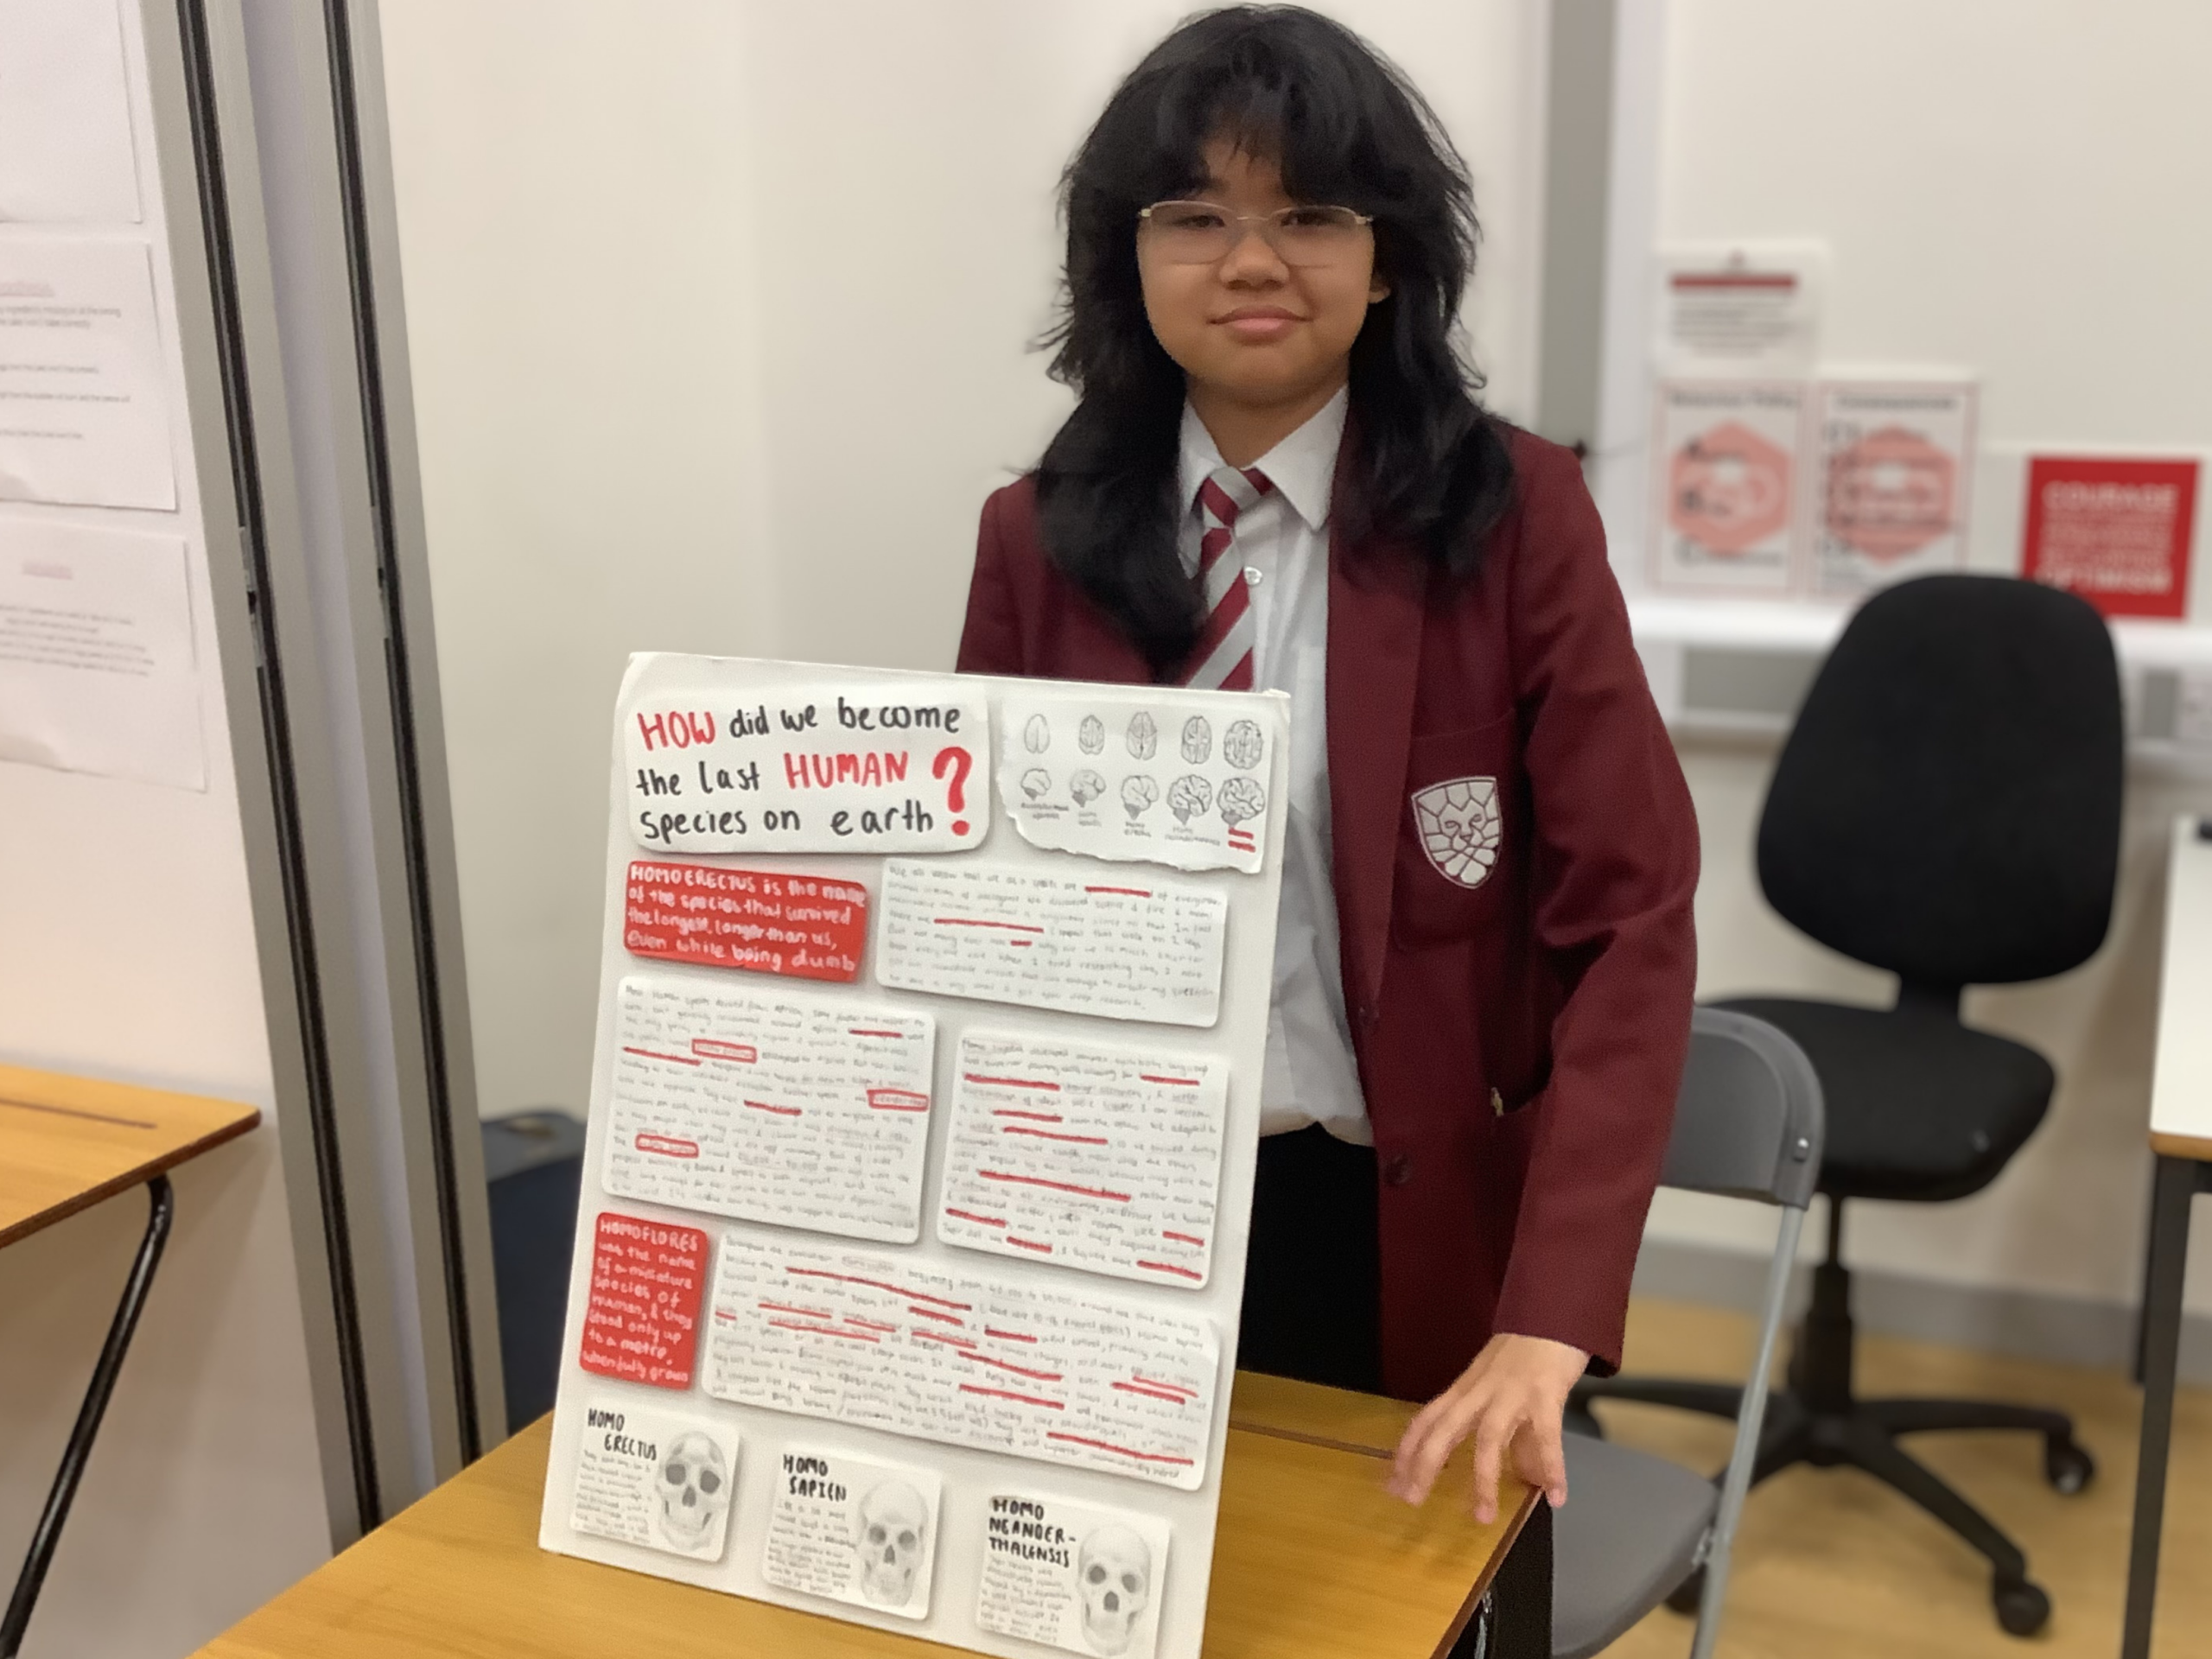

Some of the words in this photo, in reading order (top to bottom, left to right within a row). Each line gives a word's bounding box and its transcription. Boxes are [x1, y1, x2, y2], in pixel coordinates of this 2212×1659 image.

[637, 711, 716, 751] HOW
[729, 705, 770, 738] did
[780, 704, 818, 732] we
[838, 696, 961, 734] become
[636, 768, 682, 796] the
[698, 761, 761, 794] last
[784, 751, 908, 789] HUMAN
[639, 809, 747, 844] species
[764, 809, 800, 831] on
[830, 799, 934, 836] earth
[931, 747, 973, 836] ?
[631, 864, 682, 884] HOMO
[684, 869, 755, 893] ERECTUS
[763, 879, 782, 896] is
[788, 880, 817, 896] the
[629, 885, 645, 903] of
[649, 890, 675, 907] the
[744, 899, 781, 918] that
[677, 938, 726, 958] while
[731, 944, 782, 972] being
[791, 948, 855, 972] dumb
[658, 1291, 681, 1308] of
[588, 1408, 626, 1432] HOMO
[604, 1433, 657, 1461] ERECTUS
[783, 1453, 829, 1477] HOMO
[789, 1476, 847, 1502] SAPIEN
[993, 1499, 1045, 1520] HOMO
